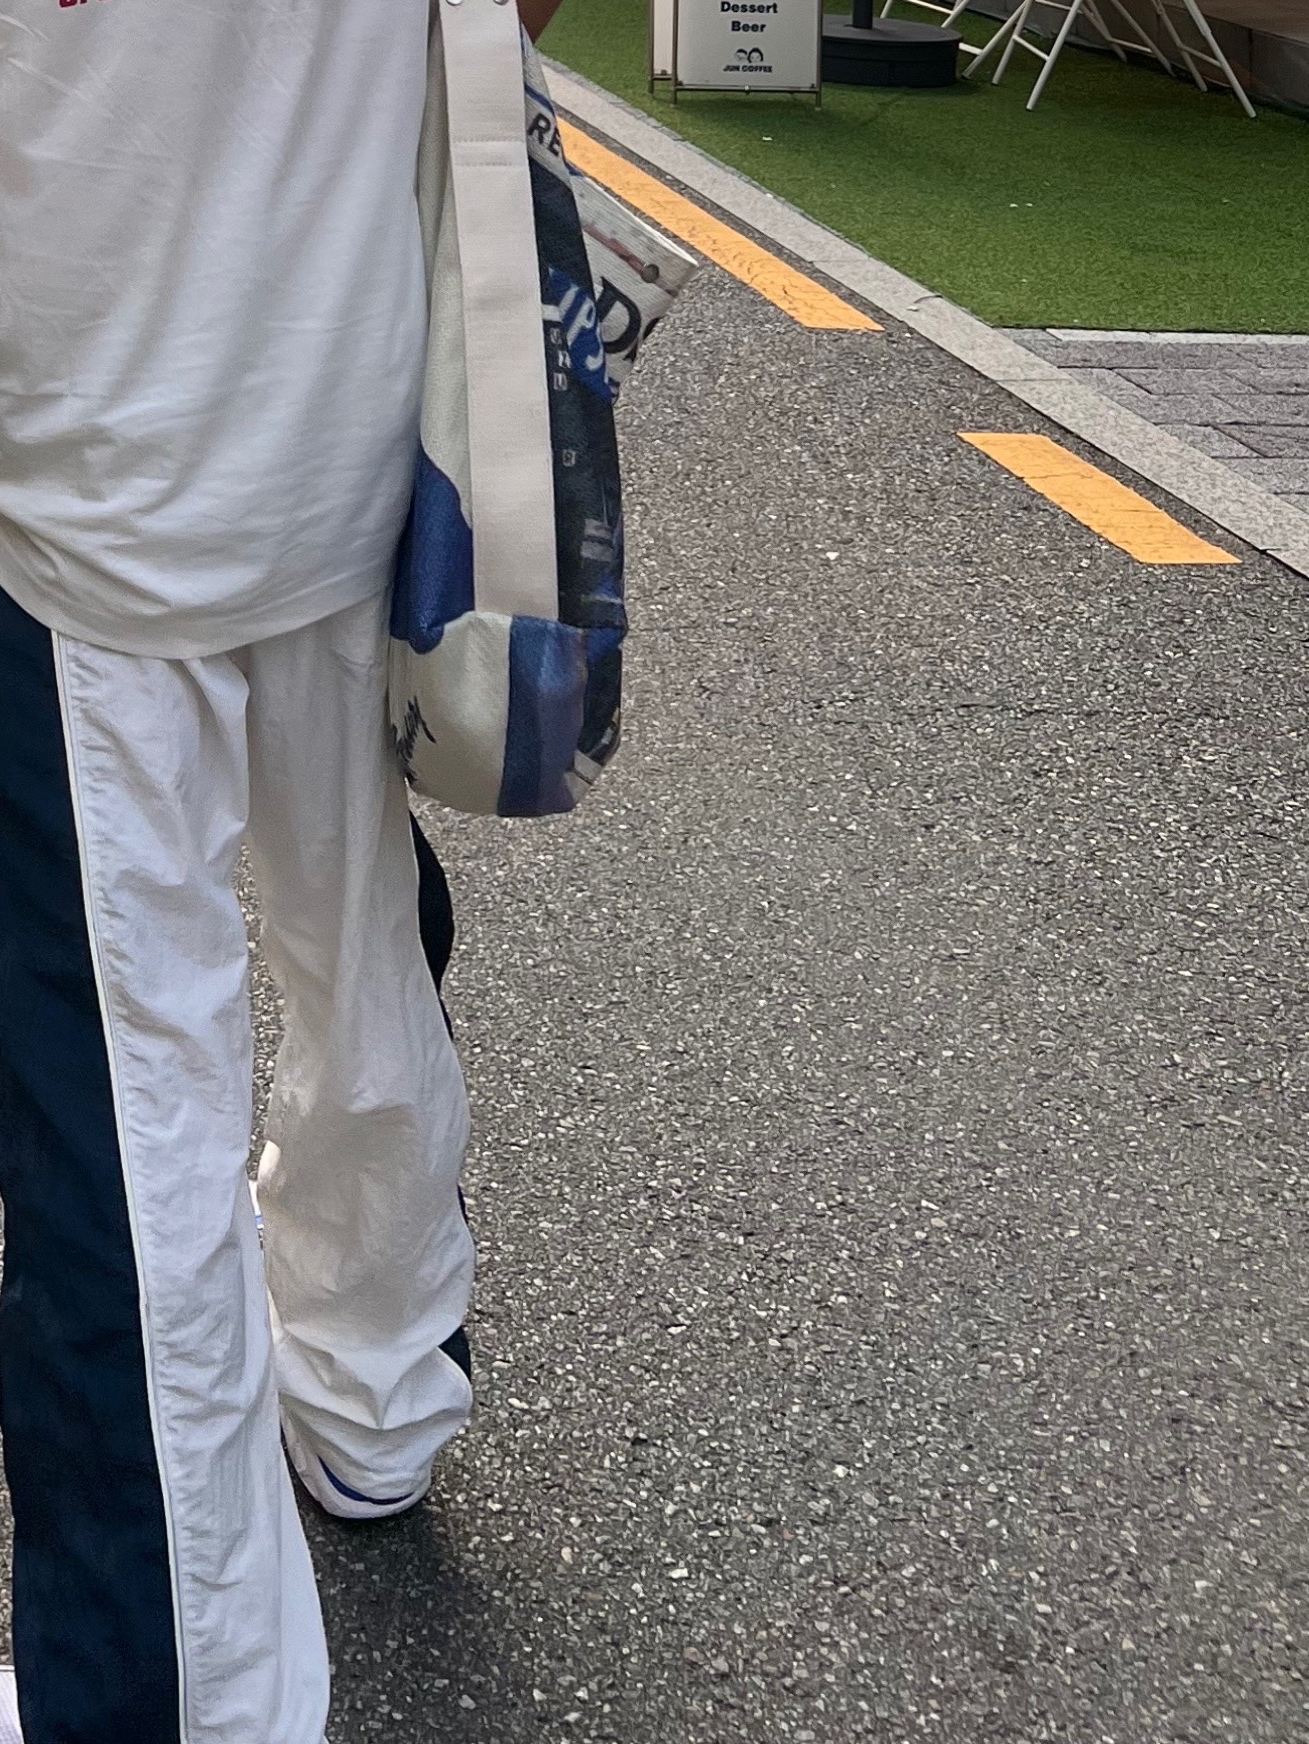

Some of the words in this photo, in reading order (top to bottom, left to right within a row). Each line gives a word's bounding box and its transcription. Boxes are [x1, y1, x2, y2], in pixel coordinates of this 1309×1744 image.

[720, 1, 778, 14] Dessert
[731, 20, 766, 33] Beer
[723, 64, 740, 73] JUN
[741, 65, 773, 73] COFFEE
